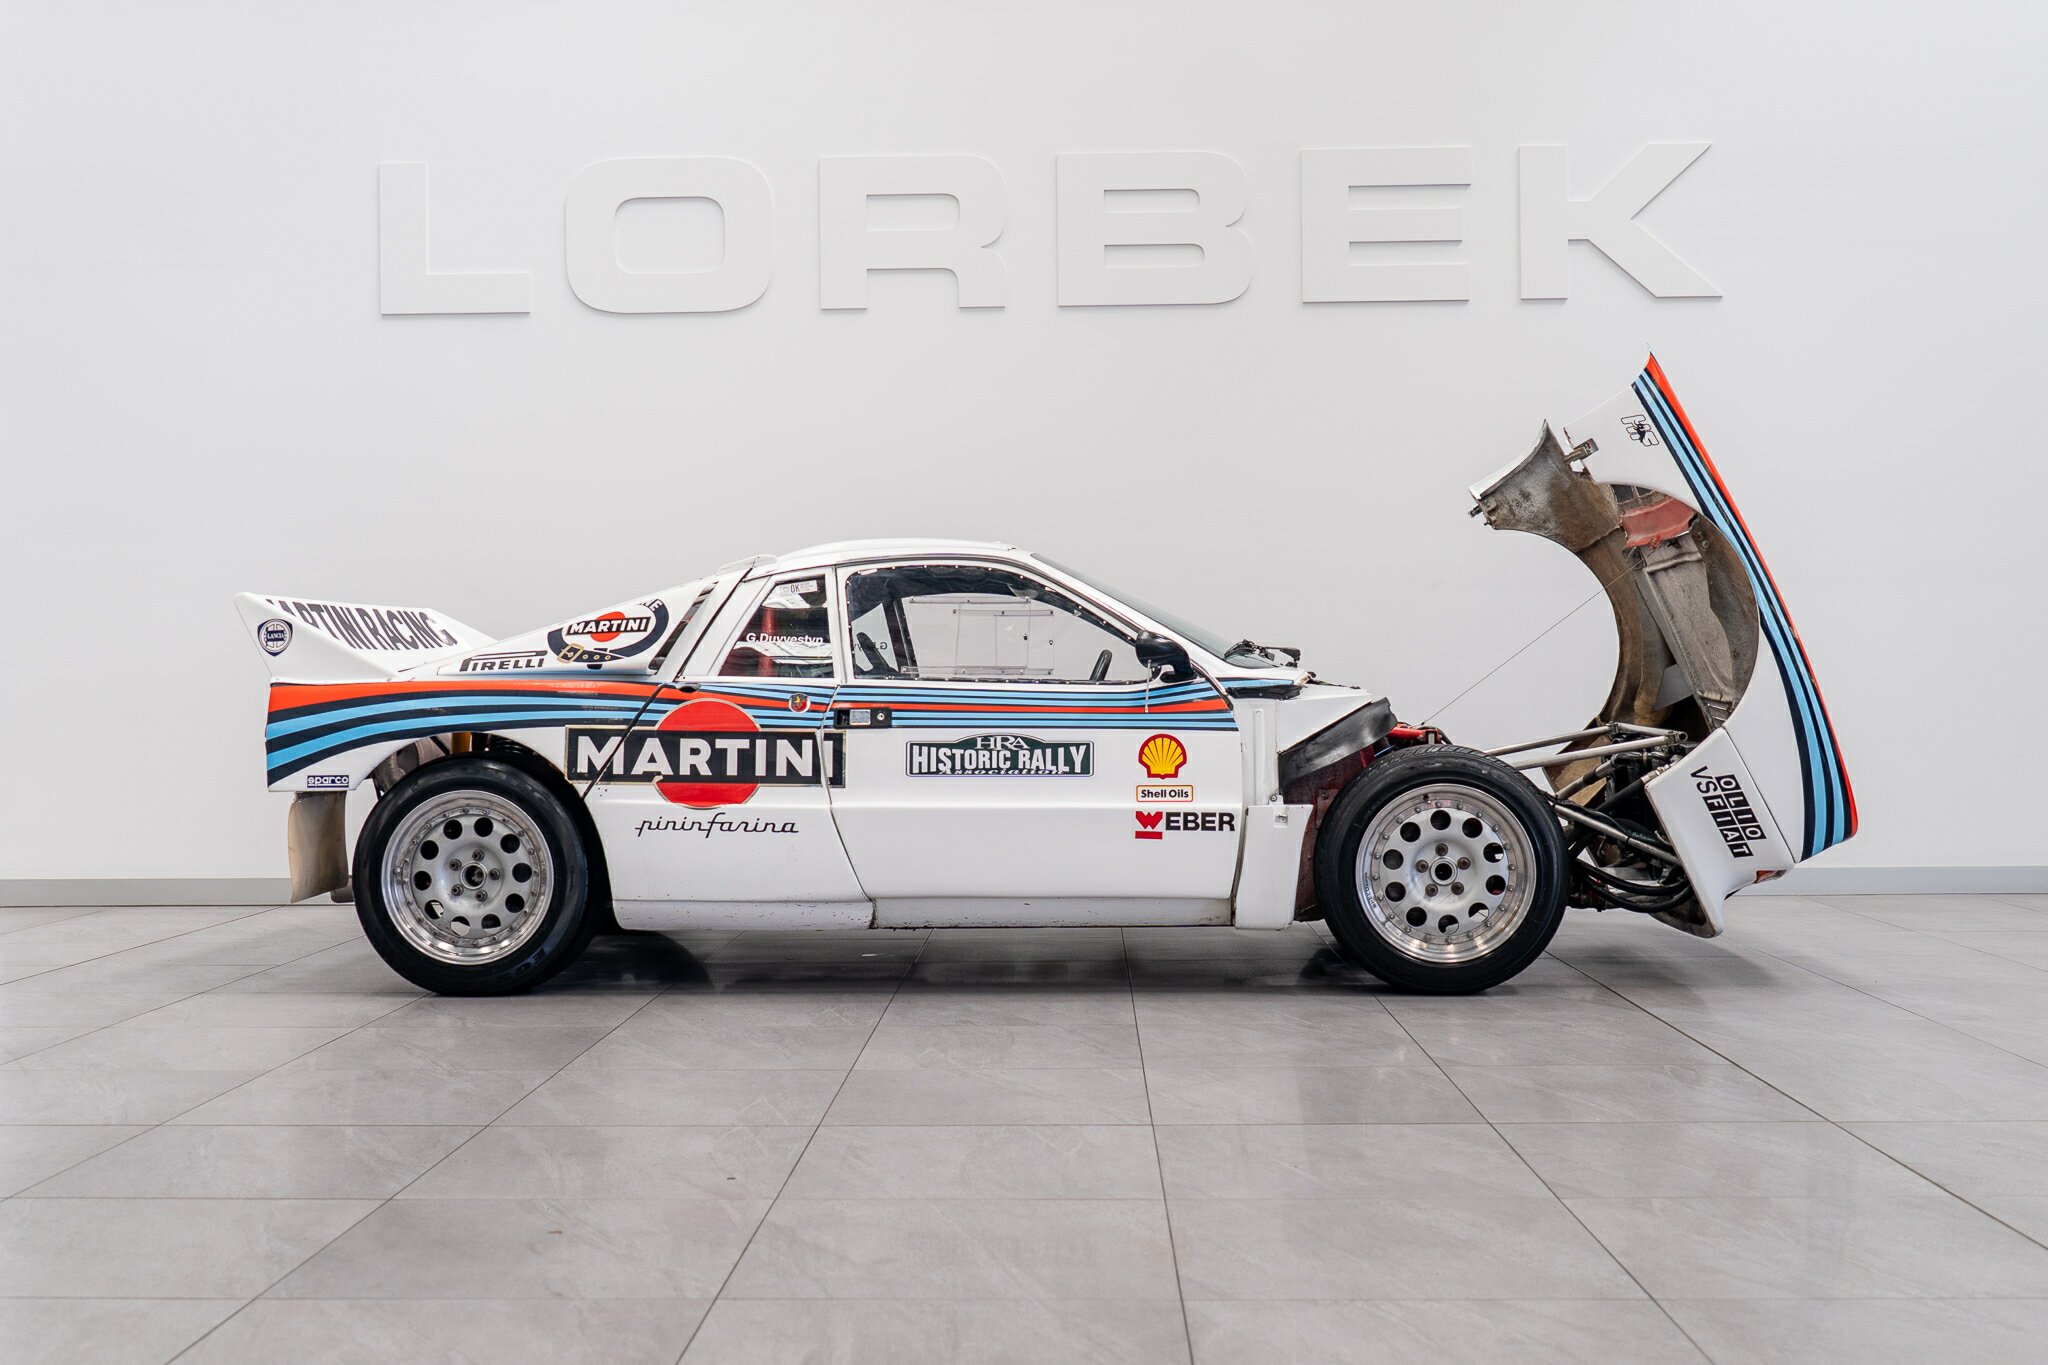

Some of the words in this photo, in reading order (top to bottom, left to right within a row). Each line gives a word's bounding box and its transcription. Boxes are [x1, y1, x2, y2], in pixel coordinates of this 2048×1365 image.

[377, 139, 1724, 316] LORBEK
[569, 617, 648, 634] MARTINI
[459, 650, 548, 672] PIRELLI
[974, 735, 1031, 750] HRA
[577, 735, 834, 778] MARTINI
[912, 745, 1011, 774] HISTORIC
[1018, 745, 1087, 774] RALLY
[307, 776, 349, 787] sparco
[1140, 789, 1167, 798] Shell
[1168, 789, 1189, 798] Oils
[1719, 777, 1763, 839] OLIO
[635, 812, 799, 839] pininfarina
[1135, 810, 1235, 832] WEBER
[1706, 797, 1750, 855] FIAT
